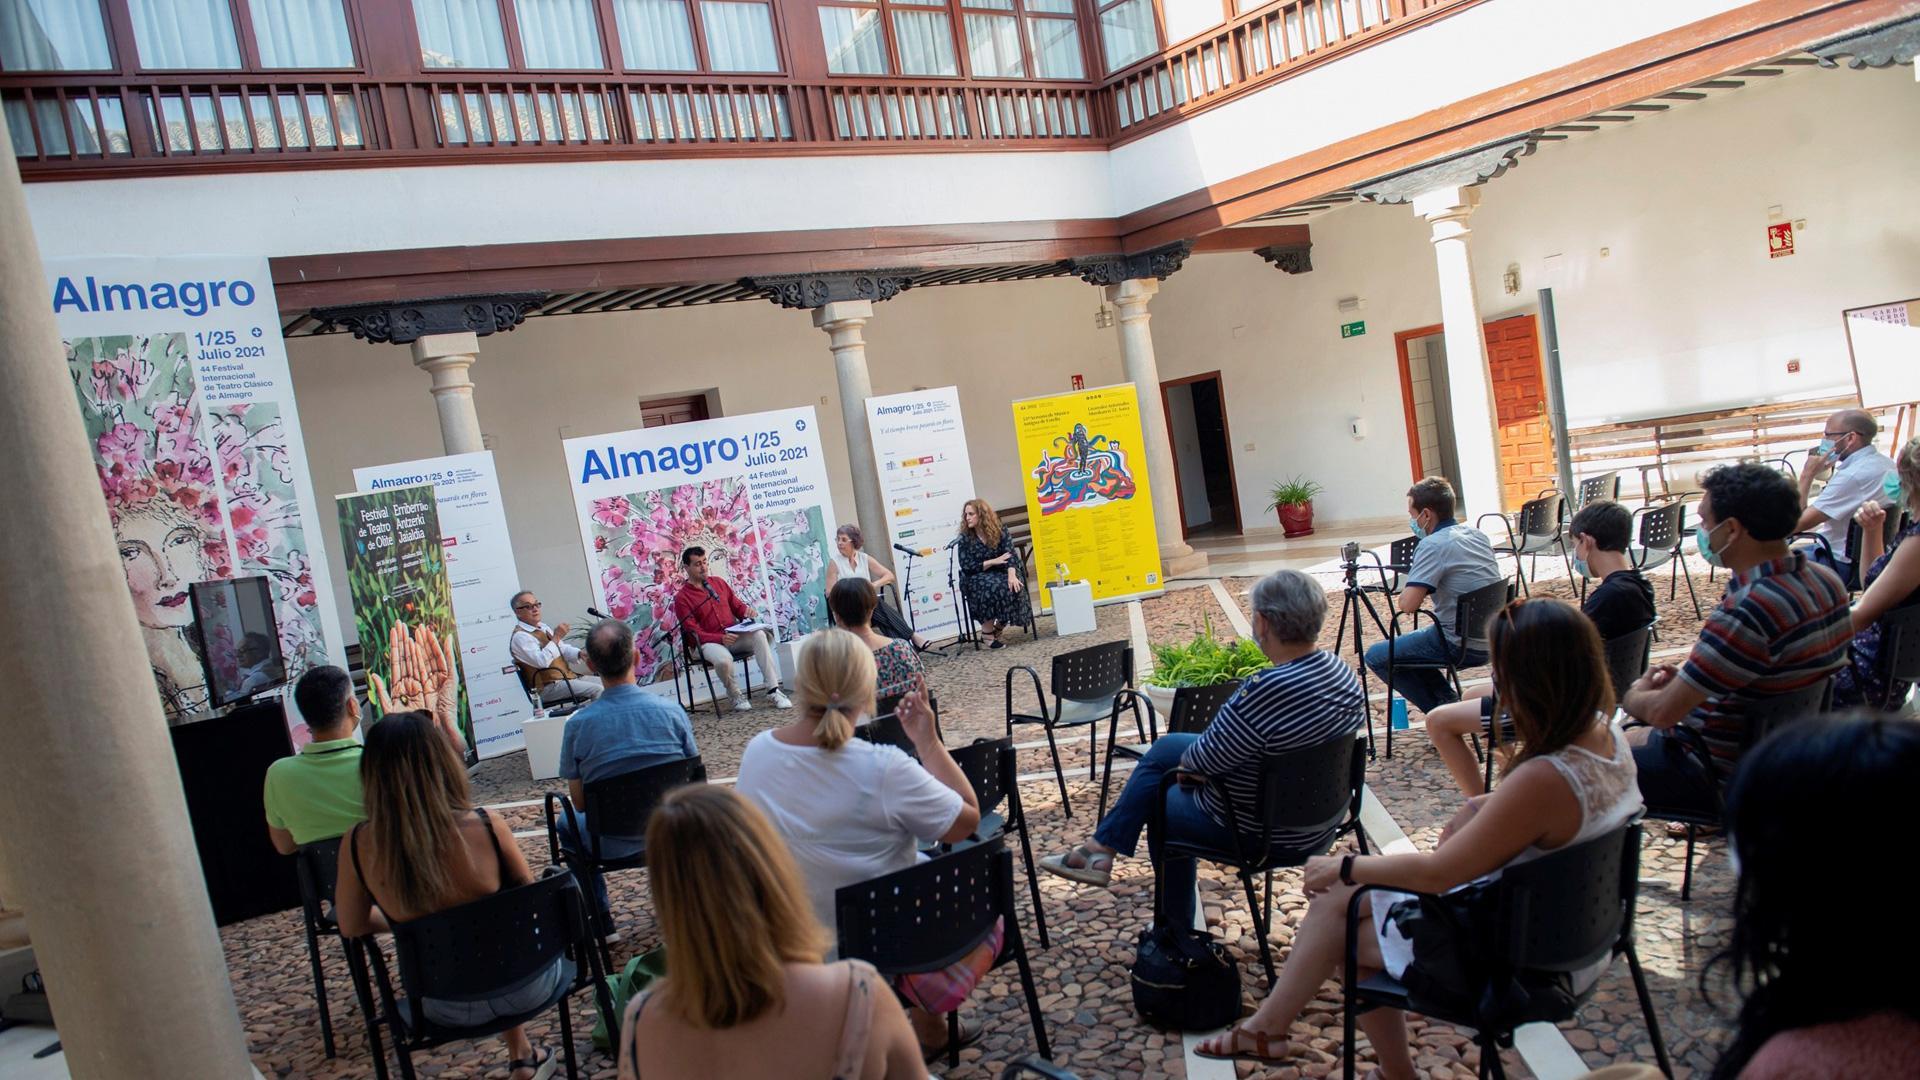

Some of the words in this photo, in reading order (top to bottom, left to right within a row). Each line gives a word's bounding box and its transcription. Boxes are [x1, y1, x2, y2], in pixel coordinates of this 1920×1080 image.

[53, 276, 255, 316] Almagro
[195, 330, 236, 346] 1/25
[198, 349, 231, 360] Julio
[235, 346, 265, 357] 2021
[212, 363, 244, 372] Festival
[202, 372, 256, 382] Internacional
[219, 391, 253, 399] Almagro
[877, 404, 911, 416] Almagro
[582, 436, 739, 484] Almagro
[741, 430, 781, 450] 1/25
[745, 452, 776, 467] Julio
[779, 446, 808, 461] 2021
[371, 474, 423, 489] Almagro
[424, 472, 443, 482] 1/25
[759, 468, 788, 479] Festival
[750, 476, 799, 490] Internacional
[752, 492, 762, 500] de
[763, 488, 786, 498] Teatro
[787, 484, 815, 494] Clásico
[765, 498, 796, 507] Almagro
[360, 506, 389, 522] Festival
[396, 513, 426, 530] Antzerki
[358, 528, 367, 537] de
[366, 522, 391, 535] Teatro
[367, 541, 376, 550] de
[375, 535, 394, 548] Olite
